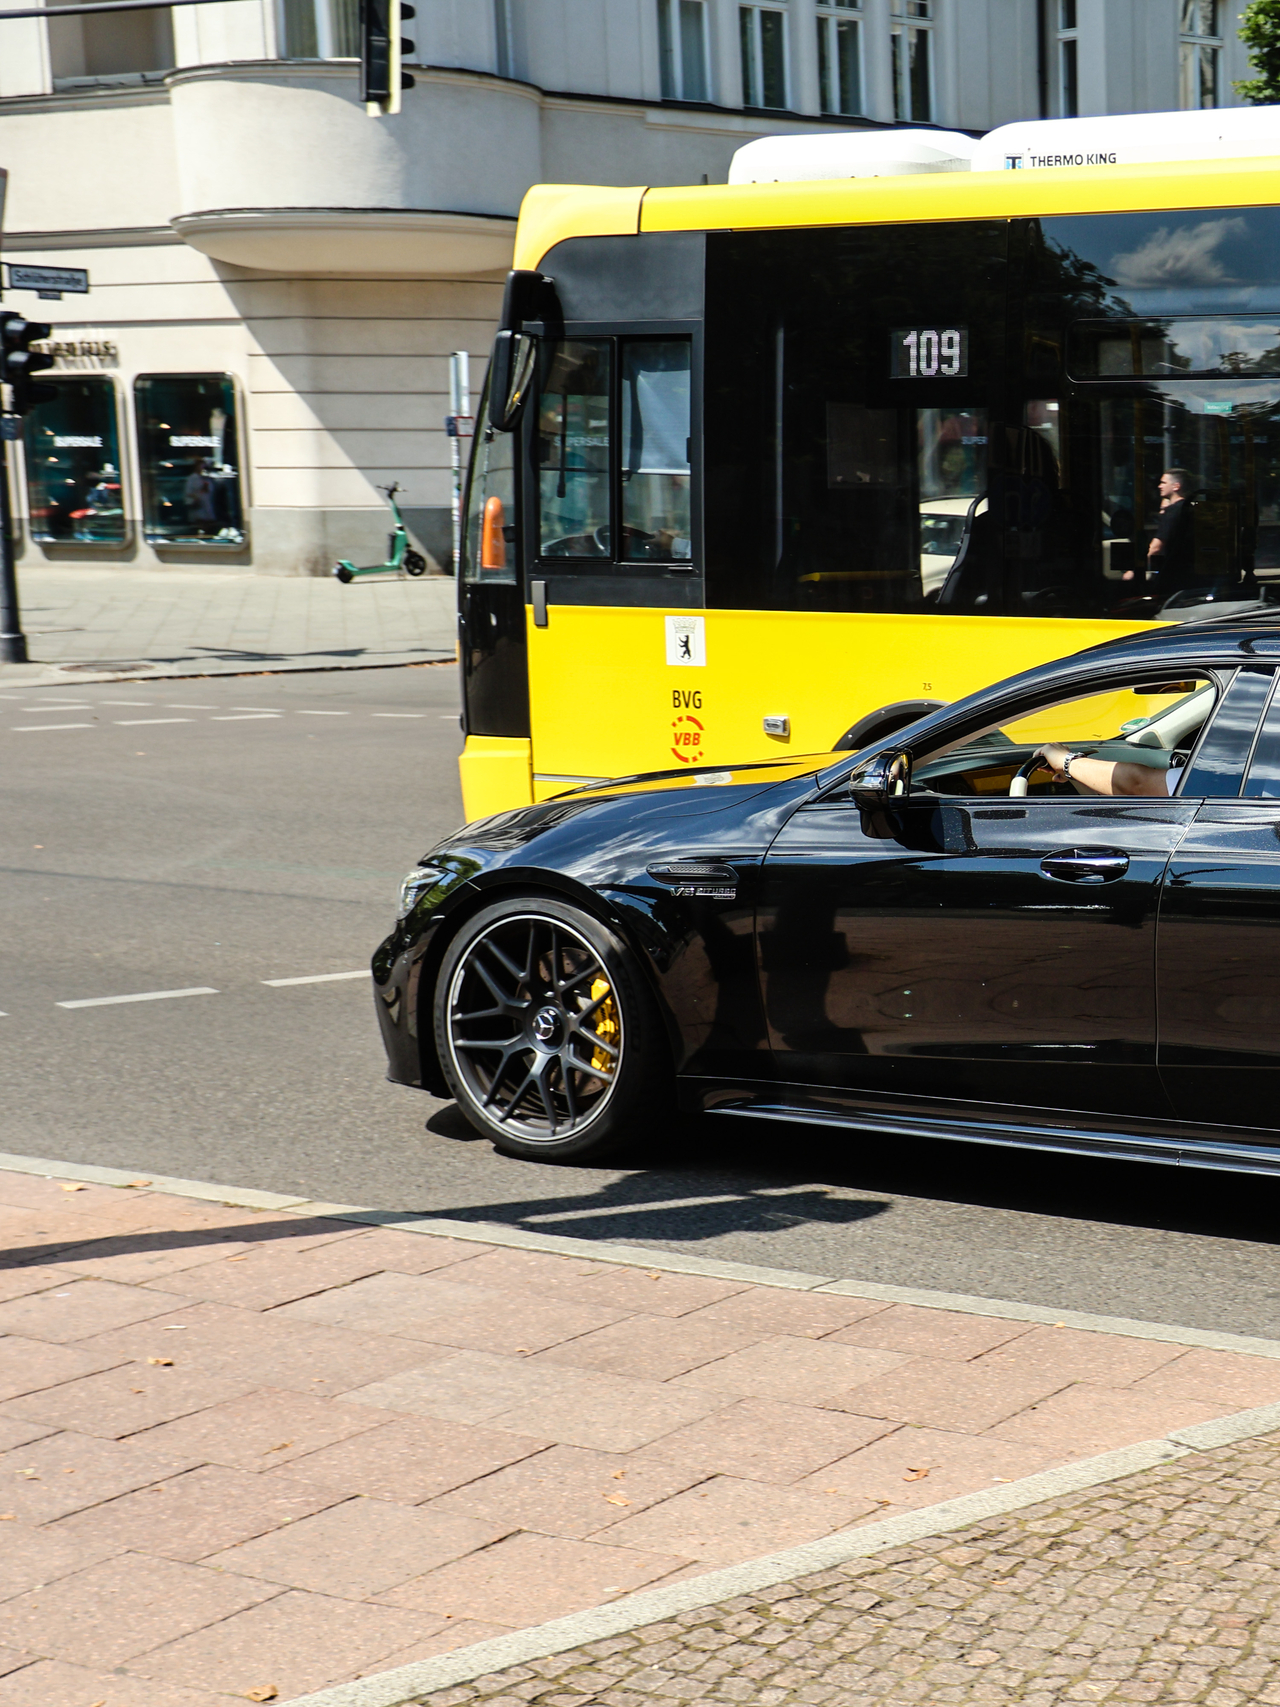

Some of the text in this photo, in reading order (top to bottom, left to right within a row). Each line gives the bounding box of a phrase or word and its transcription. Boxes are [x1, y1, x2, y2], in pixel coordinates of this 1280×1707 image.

[1030, 152, 1117, 167] THERMO KING
[903, 329, 960, 376] 109
[53, 435, 103, 447] SUPERSALE
[169, 435, 221, 447] SUPERSALE
[554, 436, 609, 447] SPERSALE
[672, 690, 702, 709] BVG
[673, 732, 701, 746] VBB
[670, 887, 737, 897] V8 BITURBO
